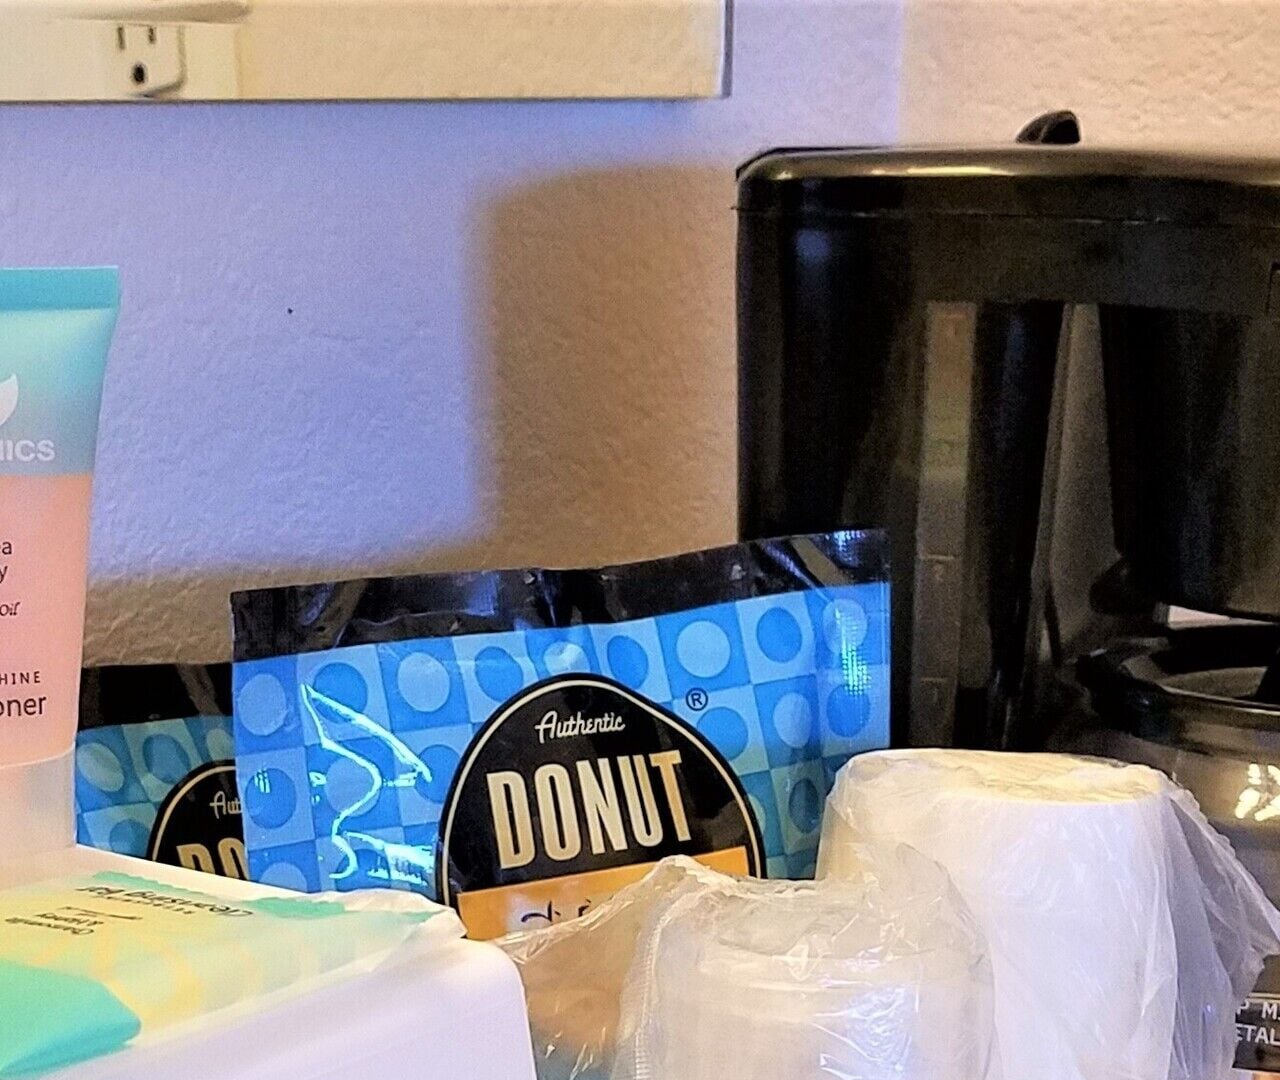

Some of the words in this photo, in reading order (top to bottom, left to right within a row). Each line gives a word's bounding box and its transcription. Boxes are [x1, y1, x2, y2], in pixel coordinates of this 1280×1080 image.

[0, 602, 20, 617] Oil
[534, 710, 626, 744] Authentic
[486, 749, 692, 870] DONUT
